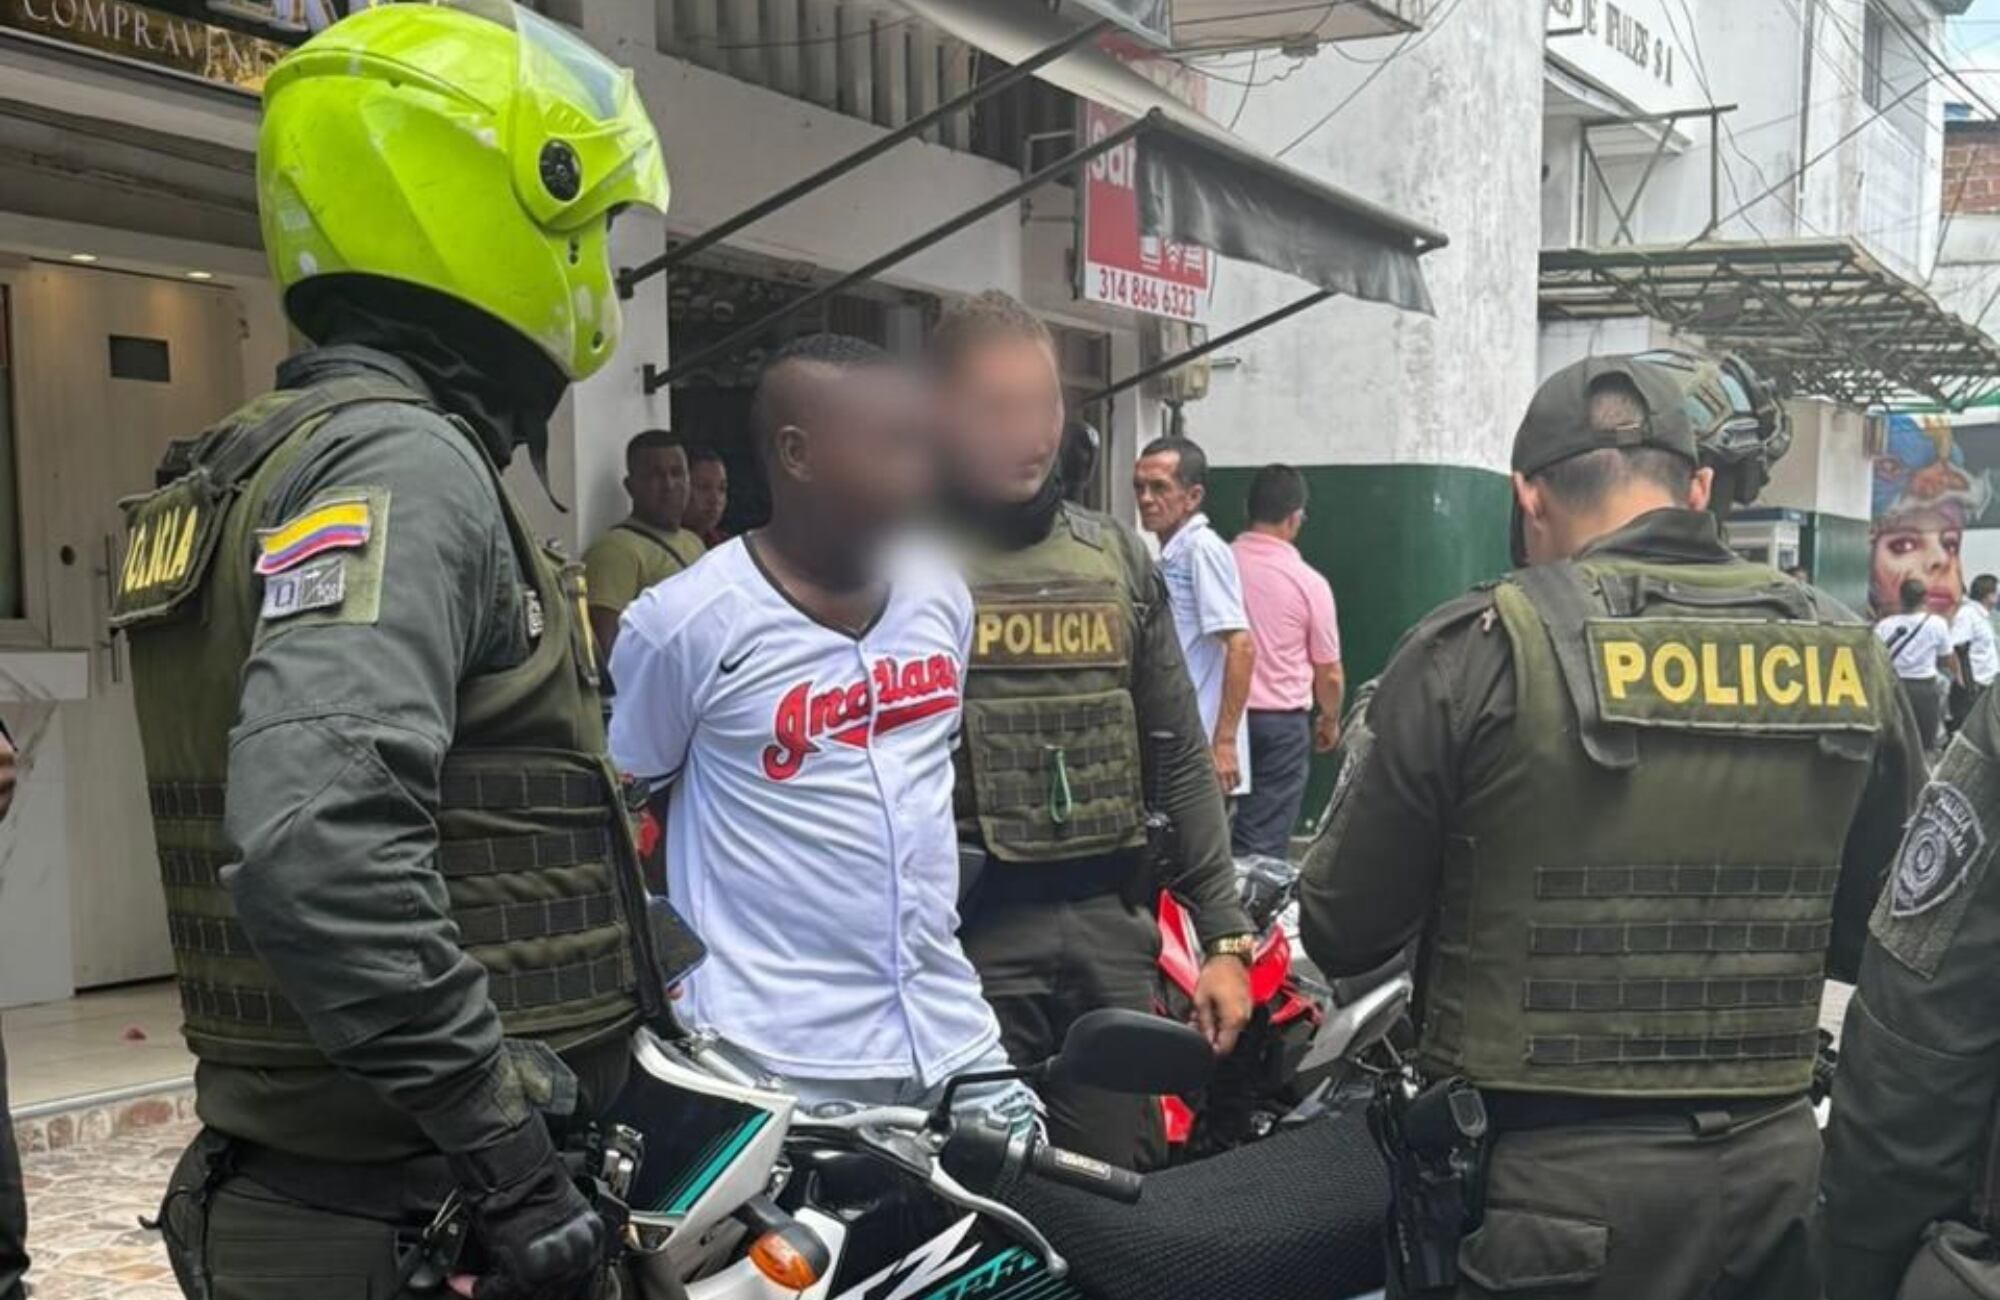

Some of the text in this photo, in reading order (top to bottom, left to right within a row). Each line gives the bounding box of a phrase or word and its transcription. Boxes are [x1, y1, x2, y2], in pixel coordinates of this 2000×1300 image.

[1099, 267, 1126, 302] 314
[978, 613, 1113, 656] POLICIA
[1603, 641, 1868, 708] POLICIA
